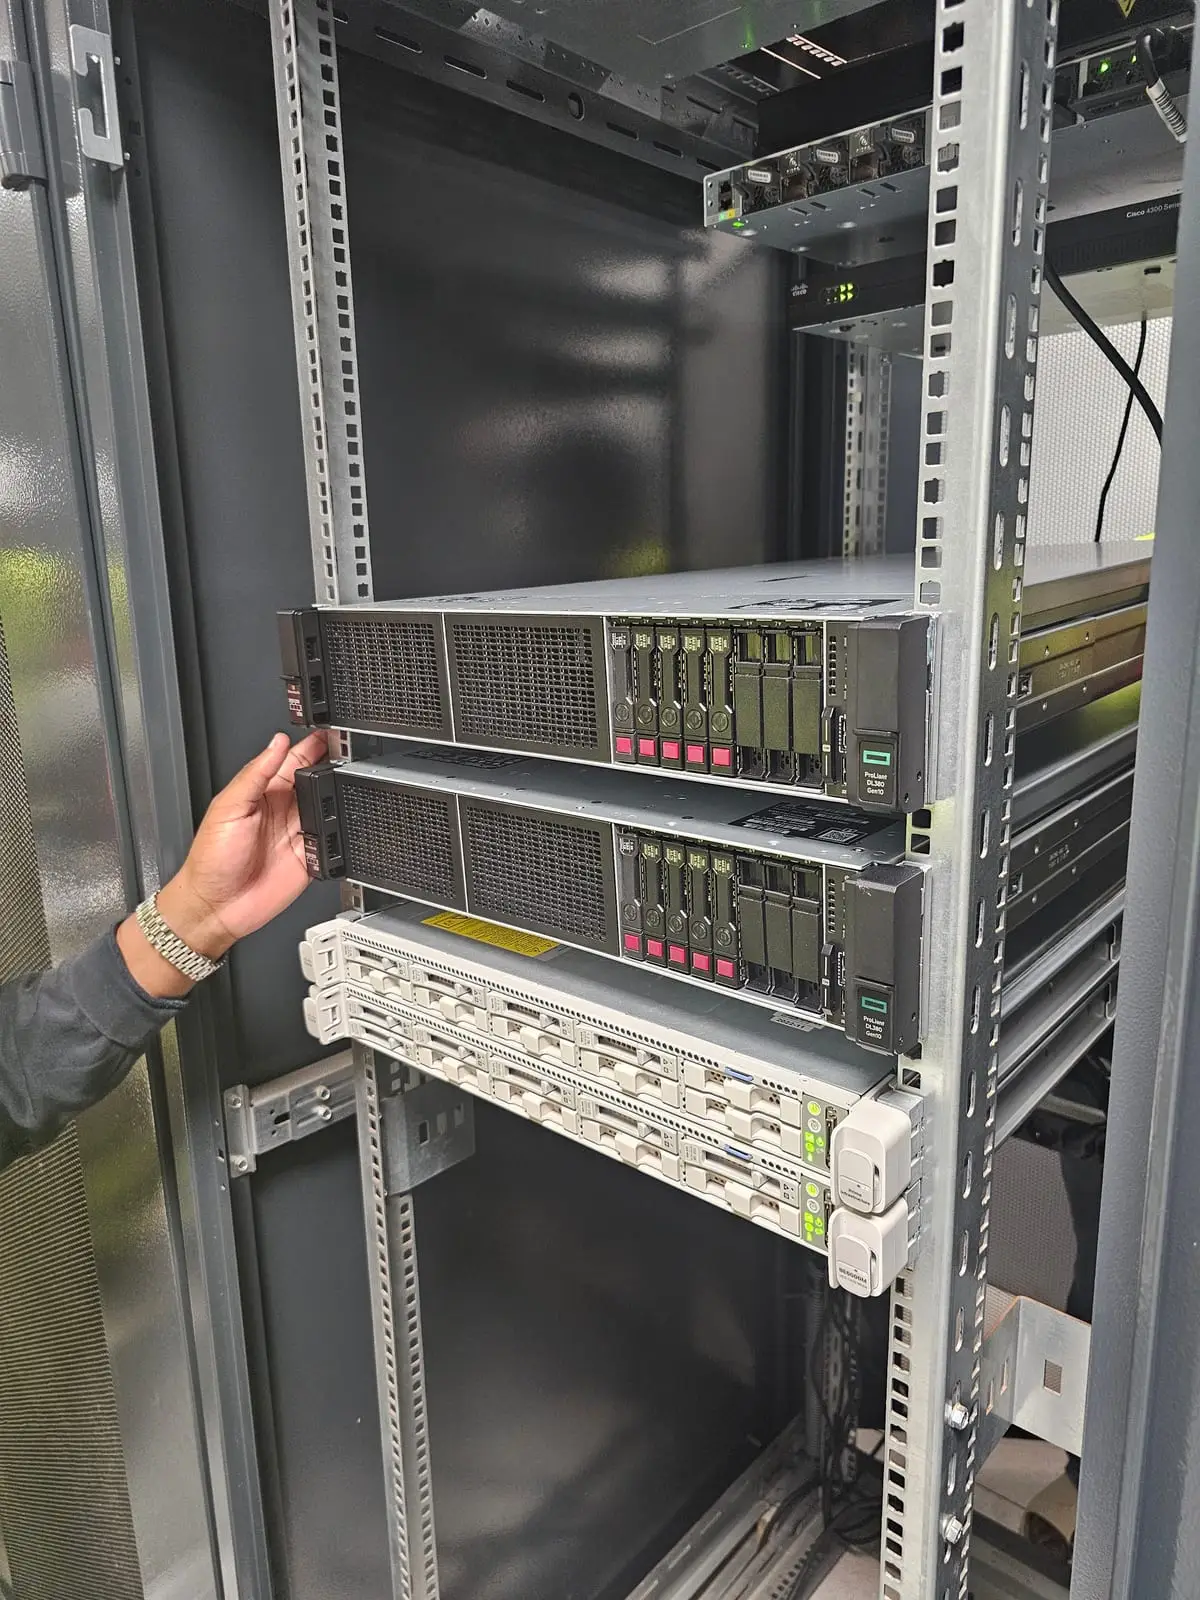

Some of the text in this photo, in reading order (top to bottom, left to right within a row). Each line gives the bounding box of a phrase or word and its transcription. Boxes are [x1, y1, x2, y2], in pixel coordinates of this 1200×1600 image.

[1126, 210, 1145, 218] Cisco
[1163, 202, 1181, 211] Serie
[864, 771, 888, 780] ProLiant
[866, 779, 885, 788] DL380
[866, 787, 884, 796] Gen10
[865, 1023, 883, 1033] DL380
